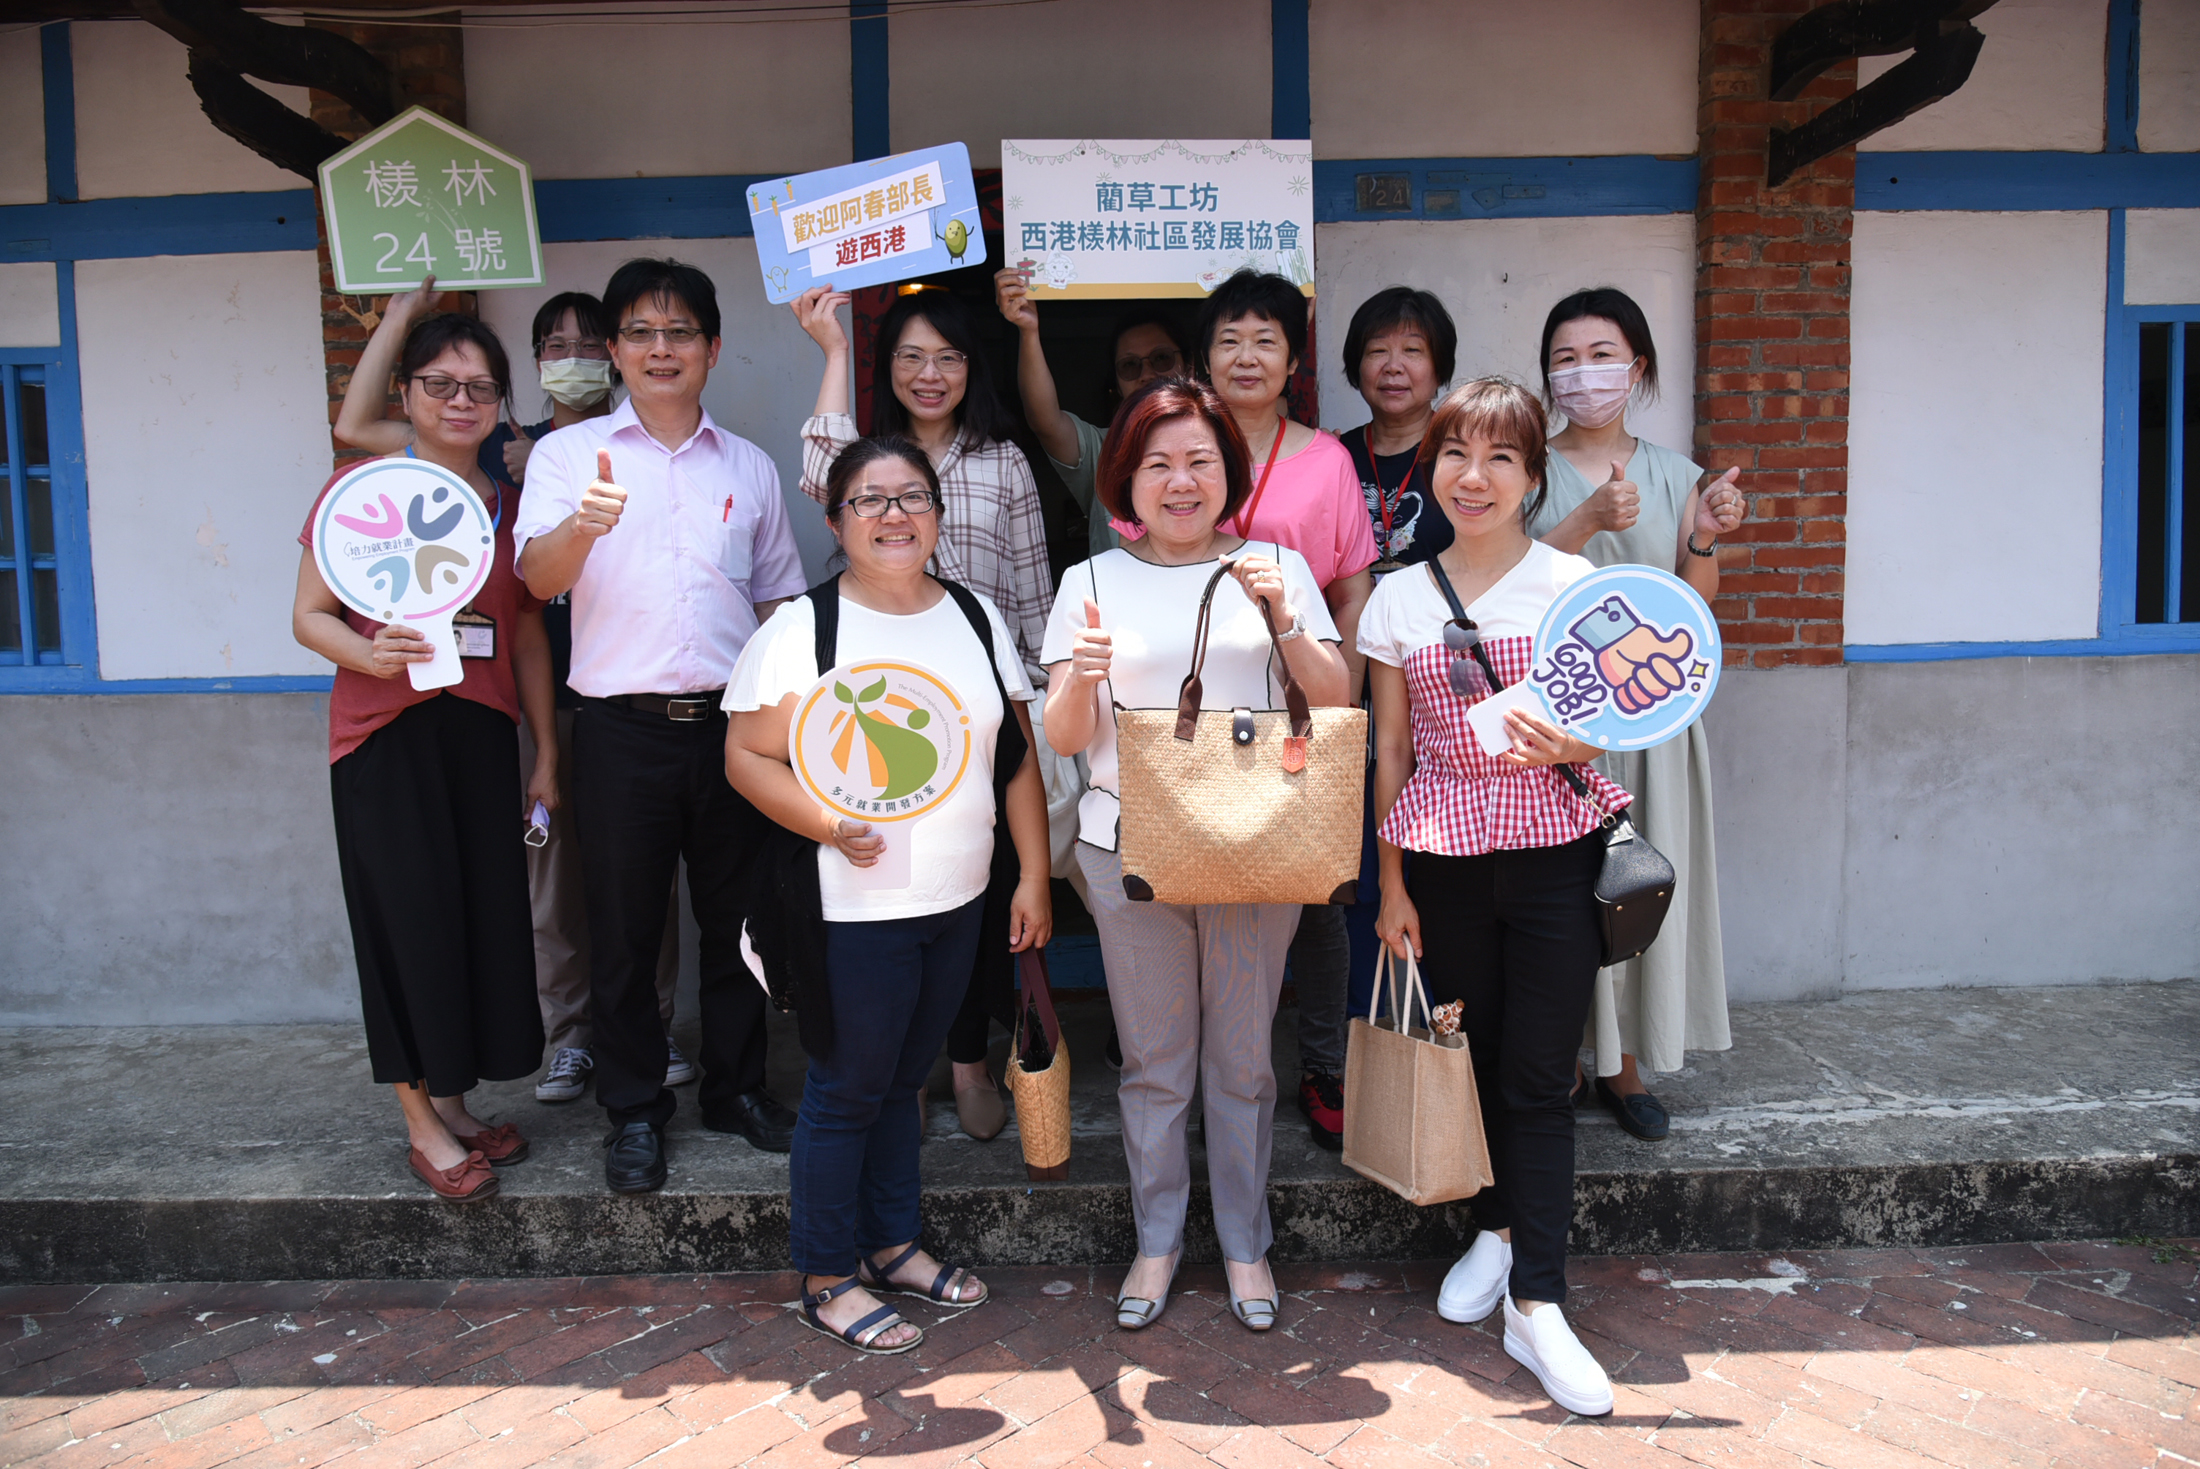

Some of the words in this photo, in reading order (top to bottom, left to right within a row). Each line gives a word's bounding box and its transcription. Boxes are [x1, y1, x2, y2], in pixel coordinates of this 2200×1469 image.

[793, 173, 933, 244] 歡迎阿春部長
[1095, 182, 1219, 213] 藺草工坊
[1376, 189, 1405, 206] 24
[835, 225, 906, 267] 遊西港
[1532, 657, 1598, 726] JOB!
[1554, 643, 1608, 704] GOOD
[829, 784, 936, 813] 多元就業開發方案
